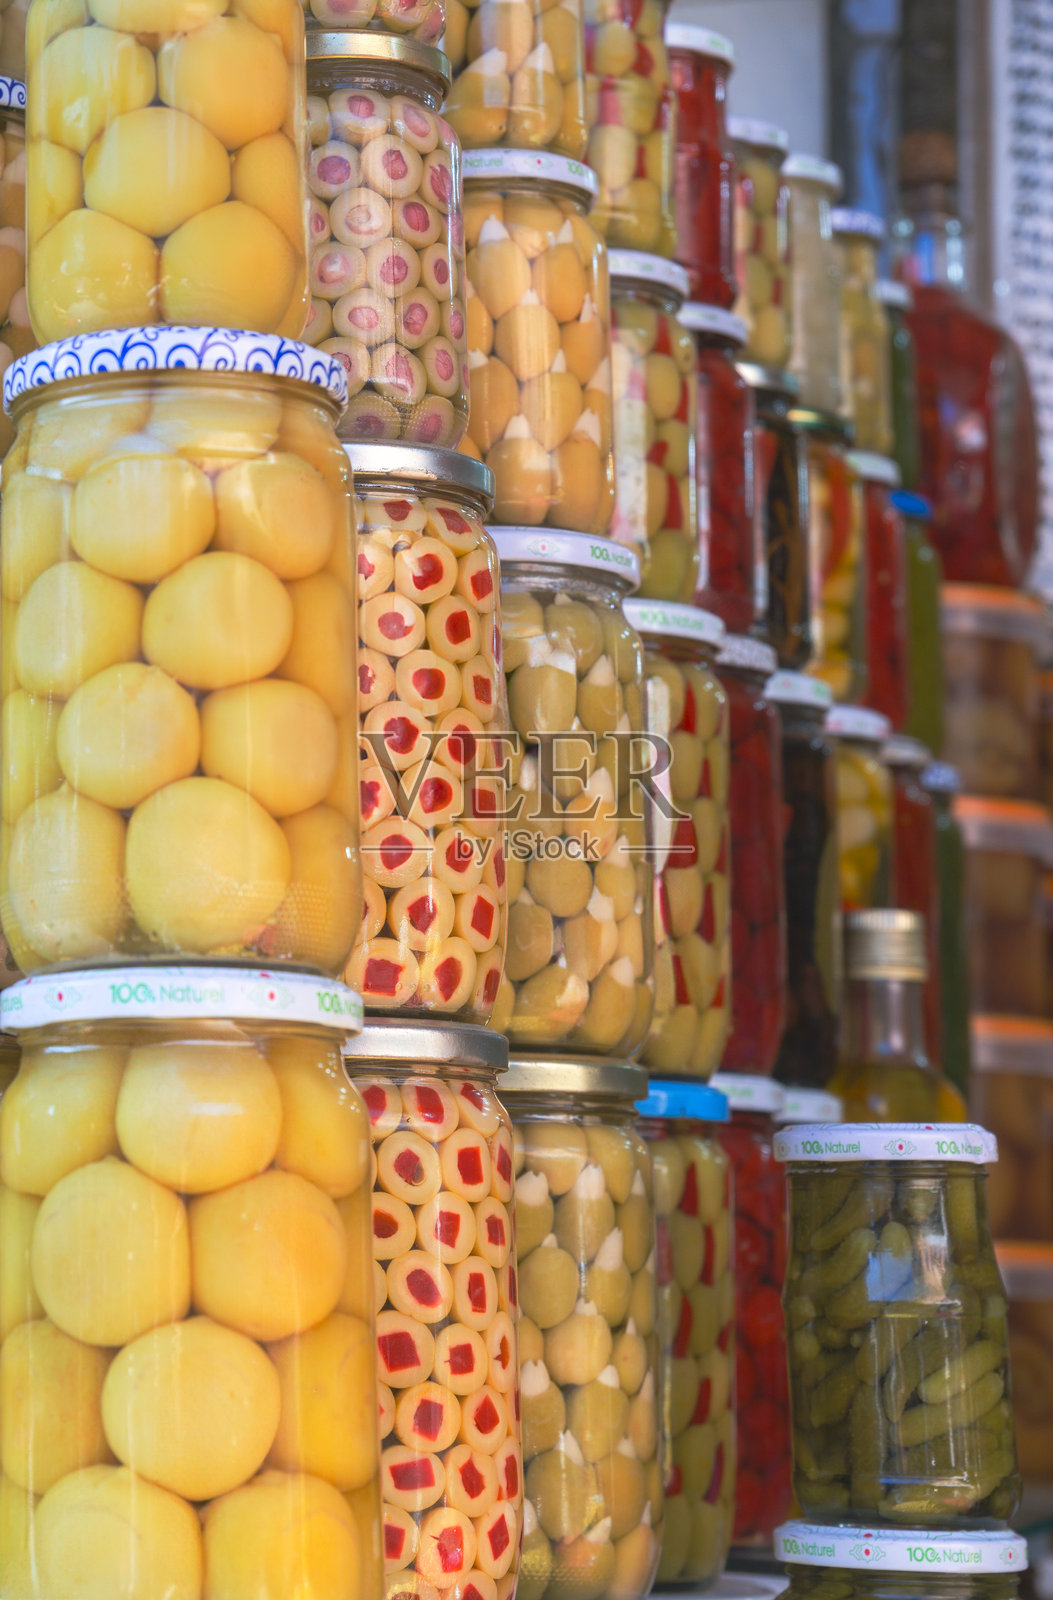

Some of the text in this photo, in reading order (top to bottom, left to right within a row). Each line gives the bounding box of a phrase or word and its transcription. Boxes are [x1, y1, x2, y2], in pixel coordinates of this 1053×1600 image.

[109, 982, 225, 1004] 100% Naturel
[825, 1140, 861, 1155] Naturel
[936, 1140, 960, 1155] 100%
[801, 1541, 836, 1558] Naturel
[906, 1546, 983, 1564] 100% Naturel
